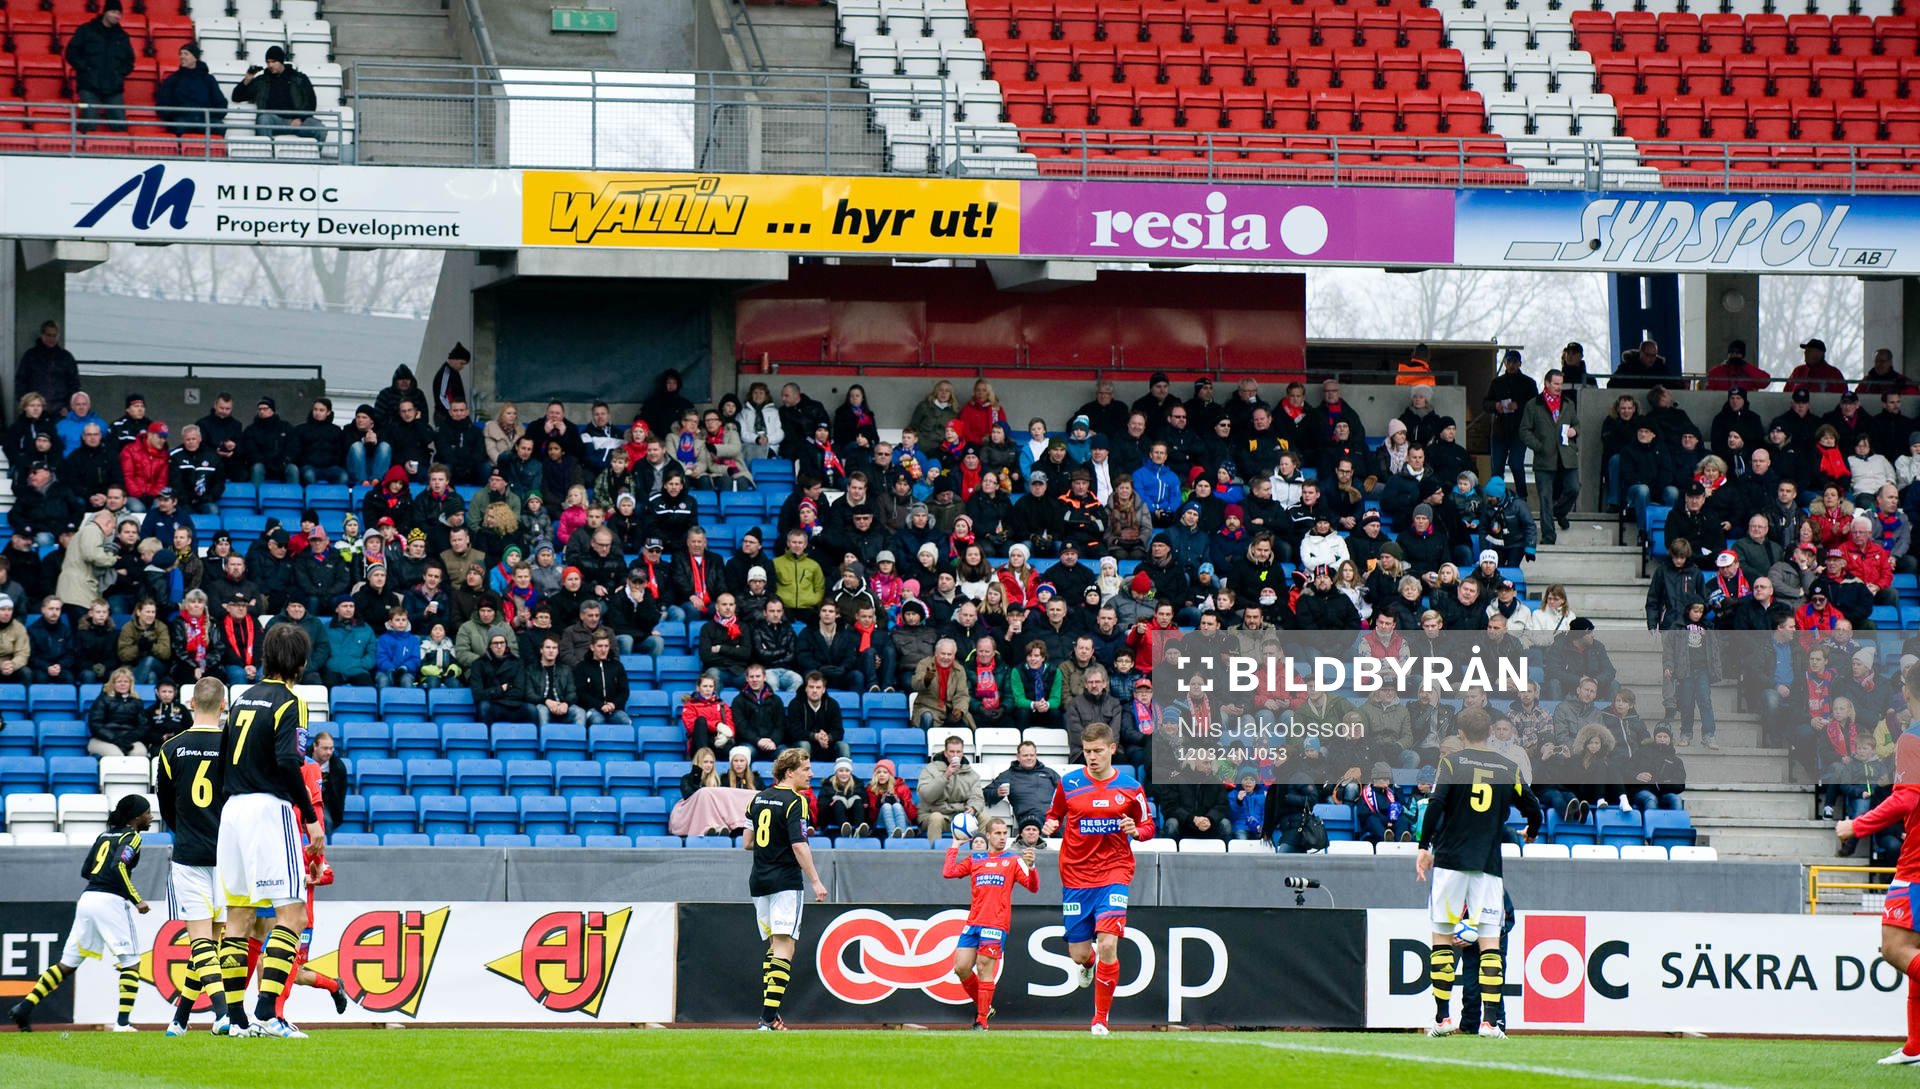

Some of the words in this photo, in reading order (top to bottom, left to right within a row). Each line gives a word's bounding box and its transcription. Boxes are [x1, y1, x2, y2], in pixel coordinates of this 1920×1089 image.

[217, 184, 339, 203] MIDROC
[216, 214, 311, 239] Property
[317, 217, 460, 241] Development
[831, 198, 914, 245] hyr
[929, 202, 999, 239] ut!
[1089, 191, 1272, 252] resia
[1557, 199, 1852, 268] SYDSPOL
[1853, 251, 1883, 266] AB
[232, 709, 257, 766] 7
[191, 759, 213, 809] 6
[1469, 767, 1495, 813] 5
[756, 808, 772, 848] 8
[1080, 826, 1107, 834] BANK
[90, 839, 111, 875] 9
[1, 932, 59, 976] ET
[1388, 938, 1630, 1000] DOC
[1660, 943, 1818, 991] SÄKRA
